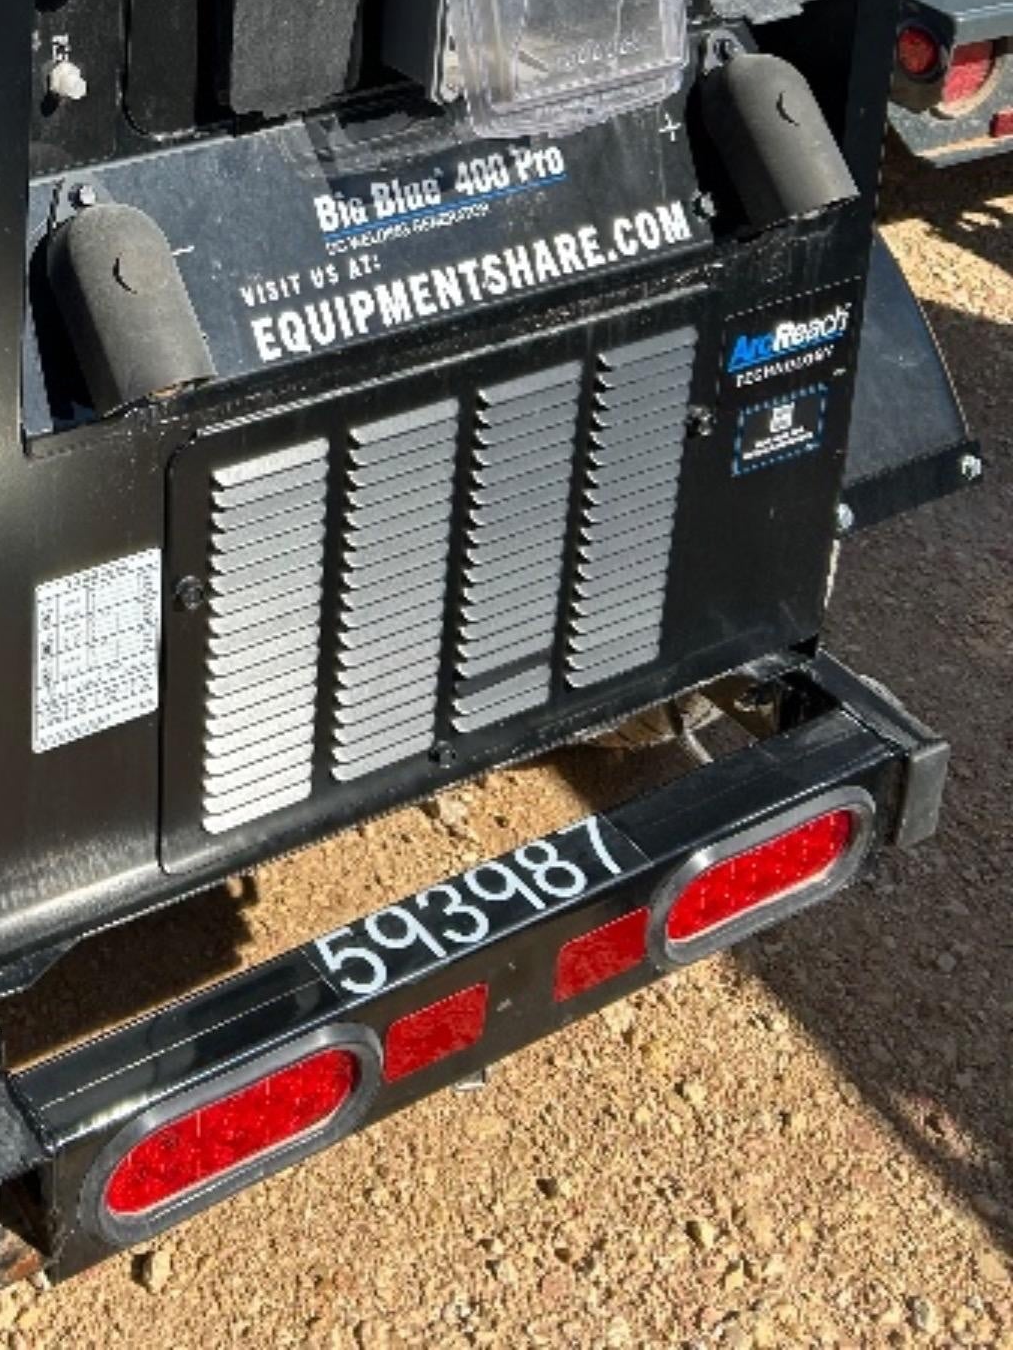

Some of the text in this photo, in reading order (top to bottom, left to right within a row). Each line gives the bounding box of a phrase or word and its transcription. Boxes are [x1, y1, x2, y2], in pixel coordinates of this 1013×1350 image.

[313, 191, 369, 233] Big
[453, 153, 510, 197] 400
[510, 146, 566, 181] Pro
[240, 254, 382, 308] VISIT US AT:
[249, 200, 693, 363] EQUIPMENTSHARE.COM
[730, 304, 850, 368] ArcReach
[312, 814, 622, 995] 593987
